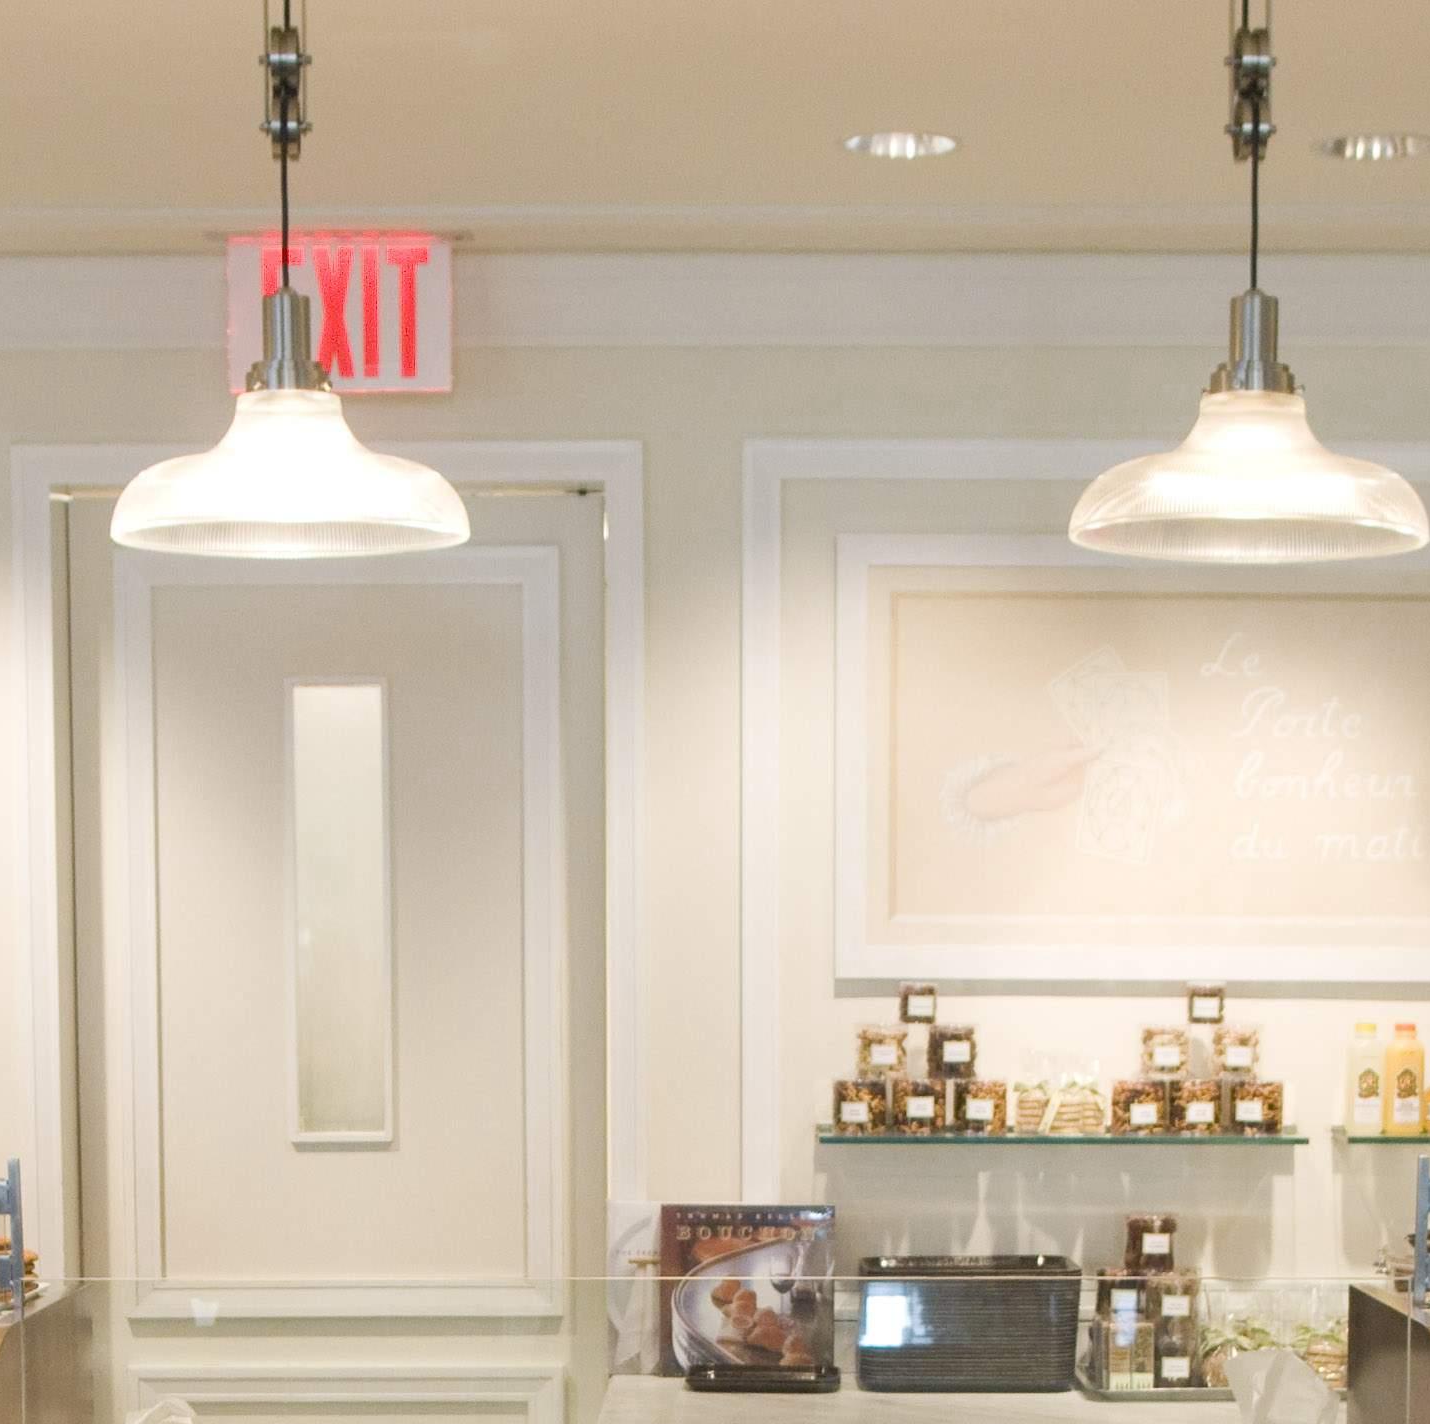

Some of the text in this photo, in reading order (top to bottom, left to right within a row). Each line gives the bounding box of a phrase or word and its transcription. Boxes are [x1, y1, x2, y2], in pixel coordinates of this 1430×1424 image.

[1199, 631, 1261, 678] Le
[1233, 750, 1418, 801] bonheur
[1229, 821, 1291, 860] du
[675, 1225, 817, 1241] BOUCHON
[676, 1212, 743, 1221] THOMAS
